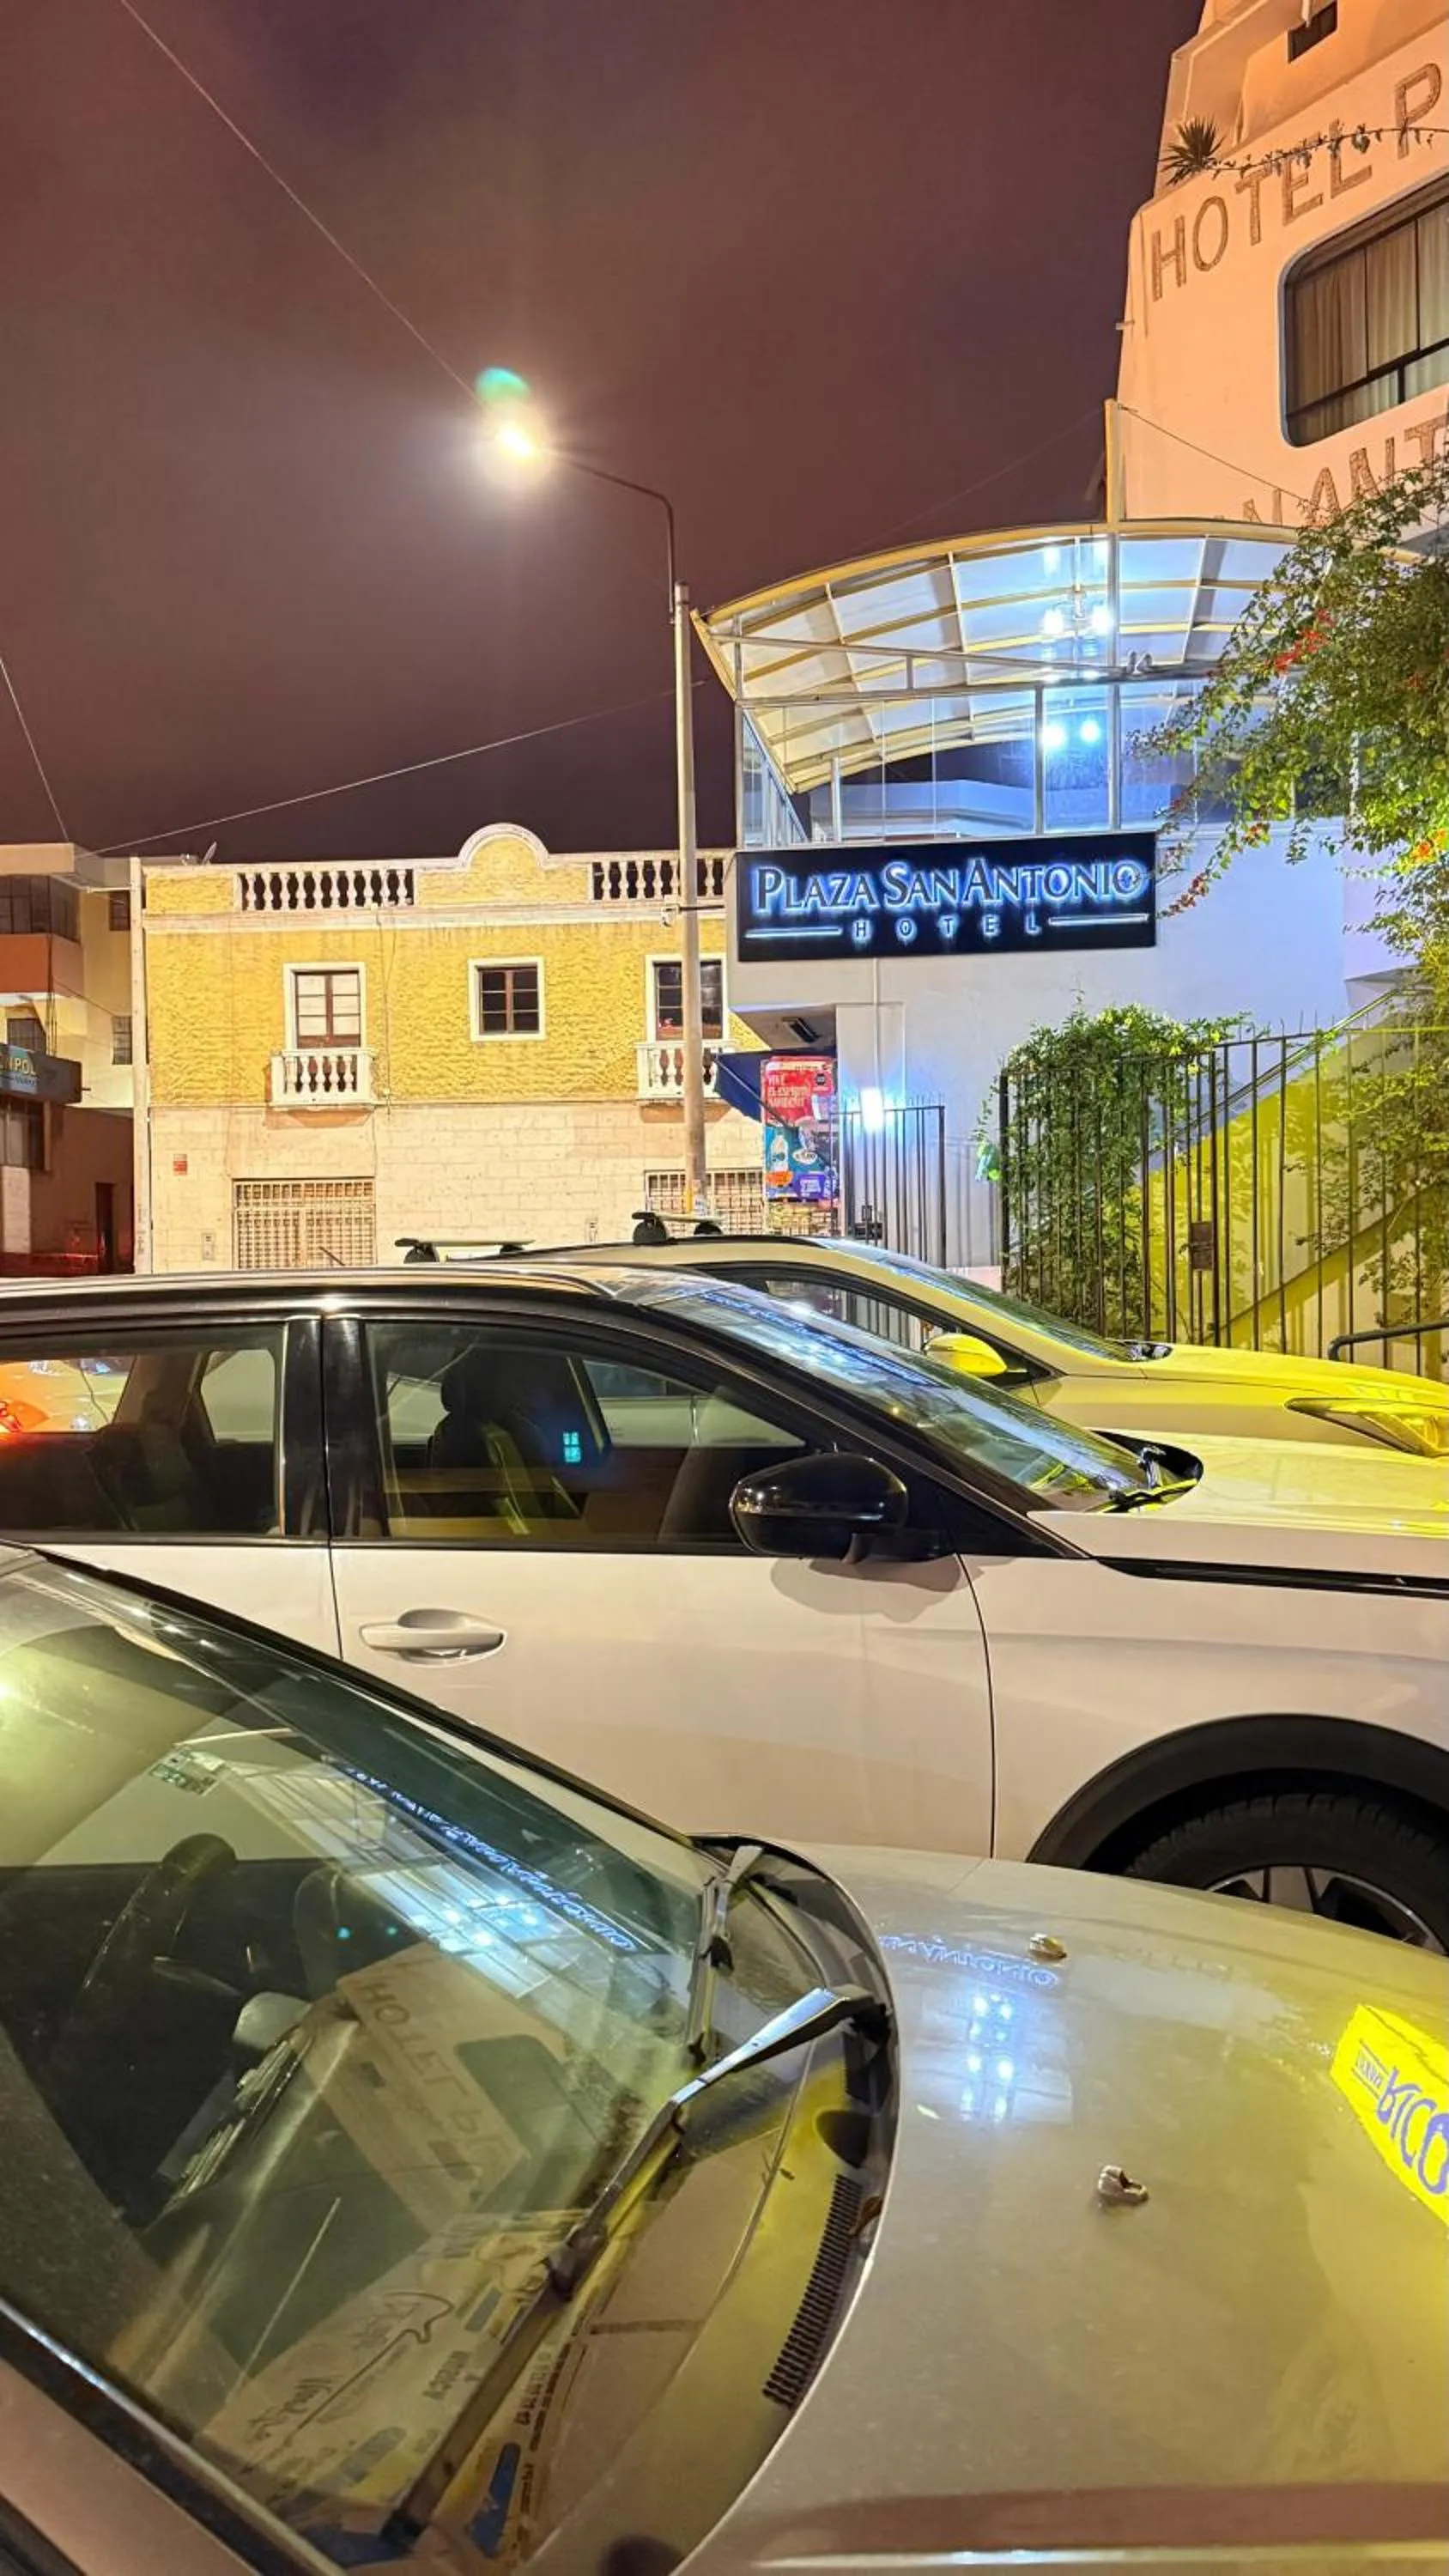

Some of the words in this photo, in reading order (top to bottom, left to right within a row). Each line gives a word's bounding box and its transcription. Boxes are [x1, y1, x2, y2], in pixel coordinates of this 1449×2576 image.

[1150, 118, 1372, 303] HOTEL
[757, 865, 877, 911] PLAZA
[852, 913, 1042, 941] HOTEL
